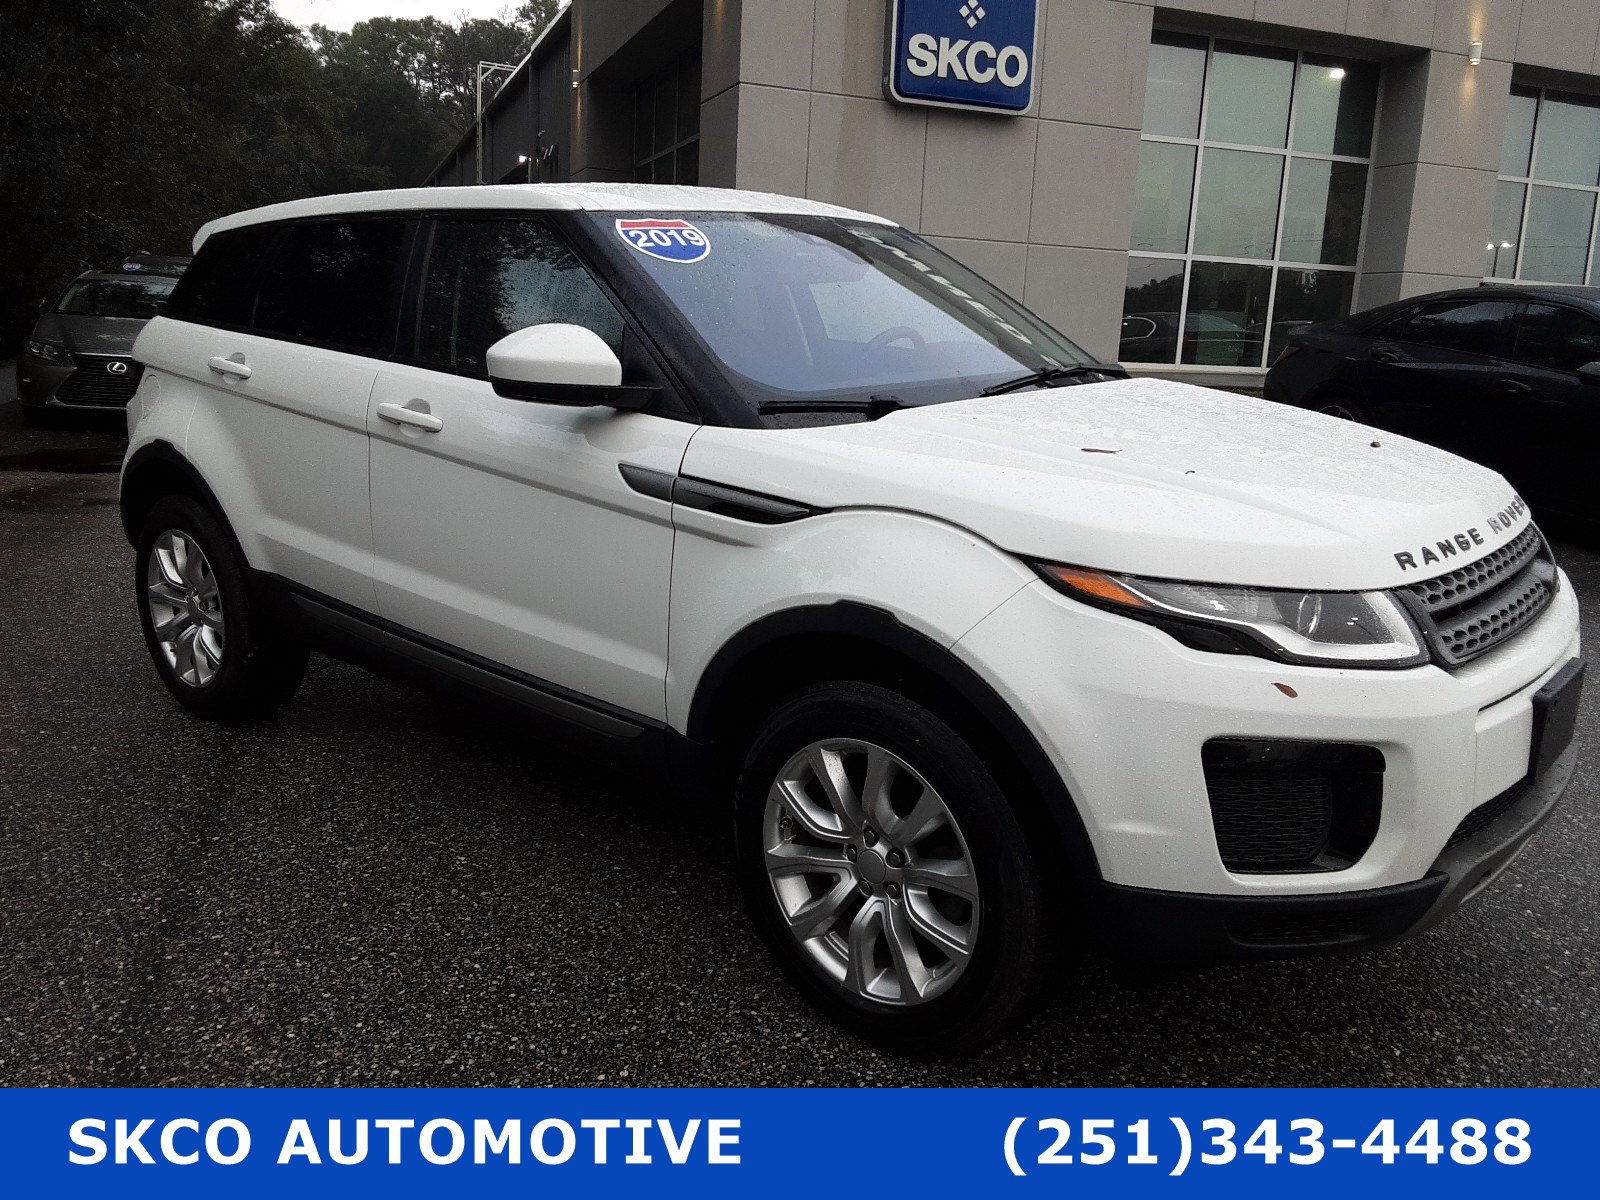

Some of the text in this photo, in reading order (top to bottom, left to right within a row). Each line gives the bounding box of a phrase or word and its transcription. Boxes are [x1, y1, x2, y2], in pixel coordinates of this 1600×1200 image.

[906, 33, 1028, 88] SKCO
[628, 229, 705, 248] 2019
[1393, 527, 1485, 572] RANGE
